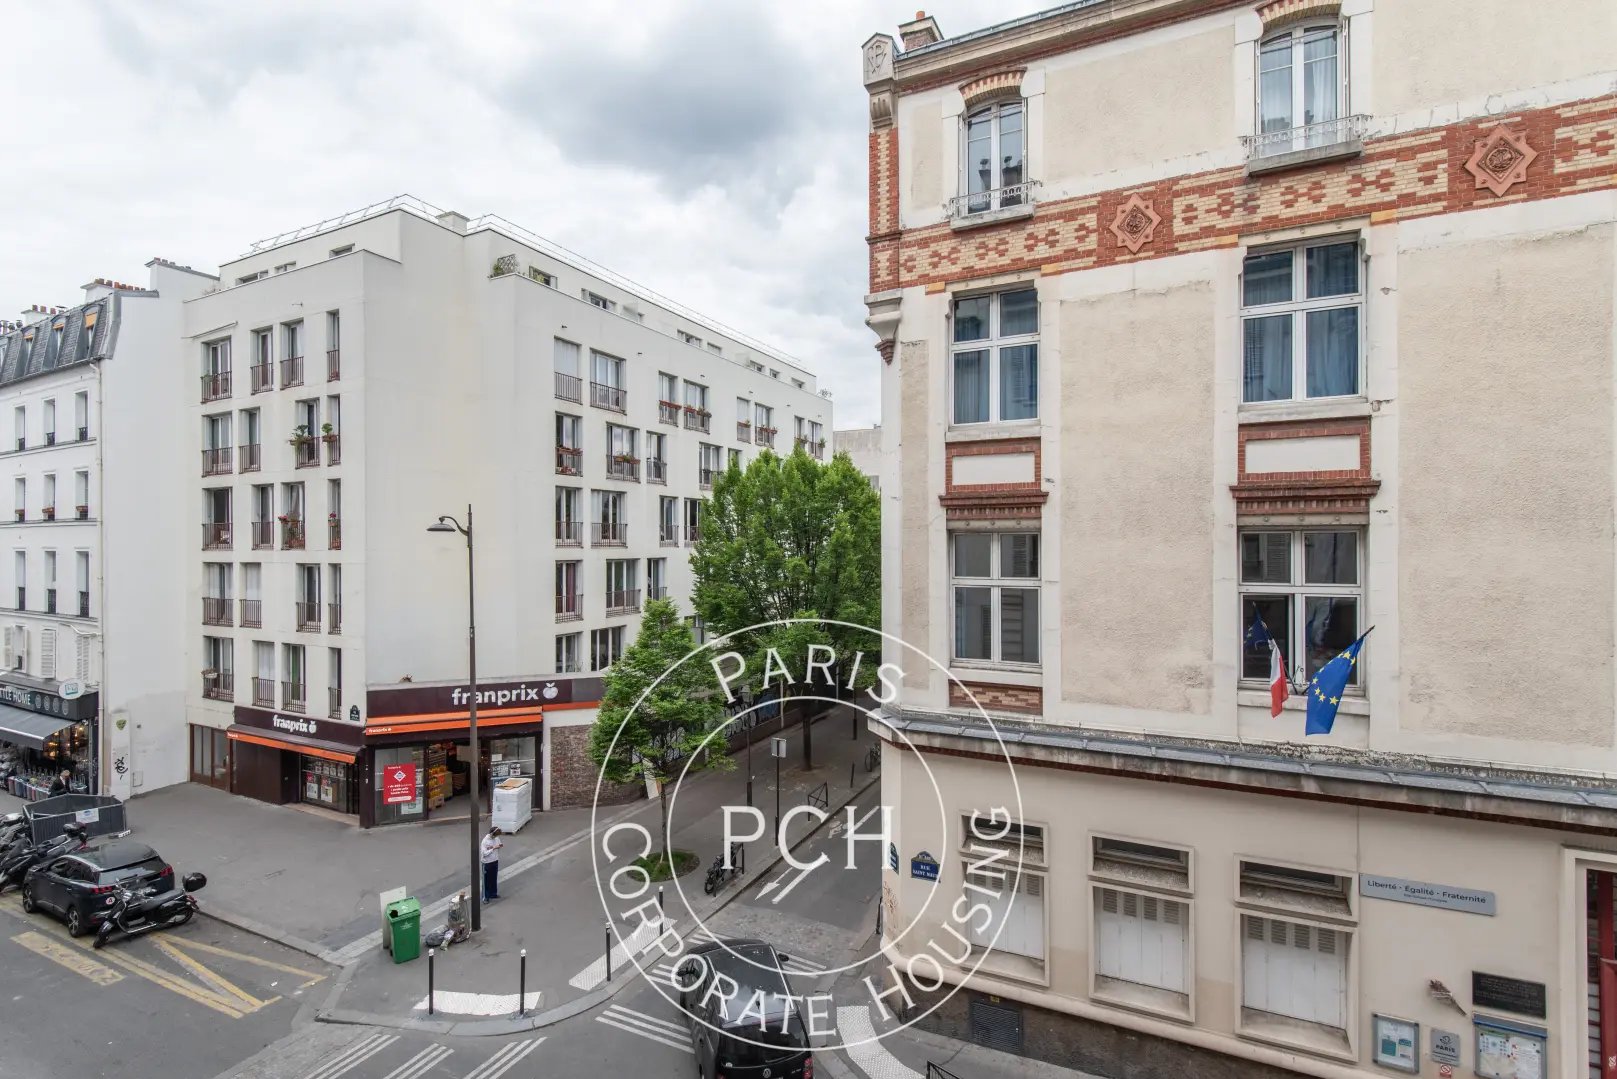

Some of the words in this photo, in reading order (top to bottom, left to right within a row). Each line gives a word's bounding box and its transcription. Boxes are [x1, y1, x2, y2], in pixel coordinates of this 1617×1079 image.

[13, 691, 31, 706] HOME
[452, 684, 539, 706] franprix
[272, 714, 308, 732] franprix
[1367, 880, 1397, 890] Liberté
[1442, 891, 1486, 904] Fraternité
